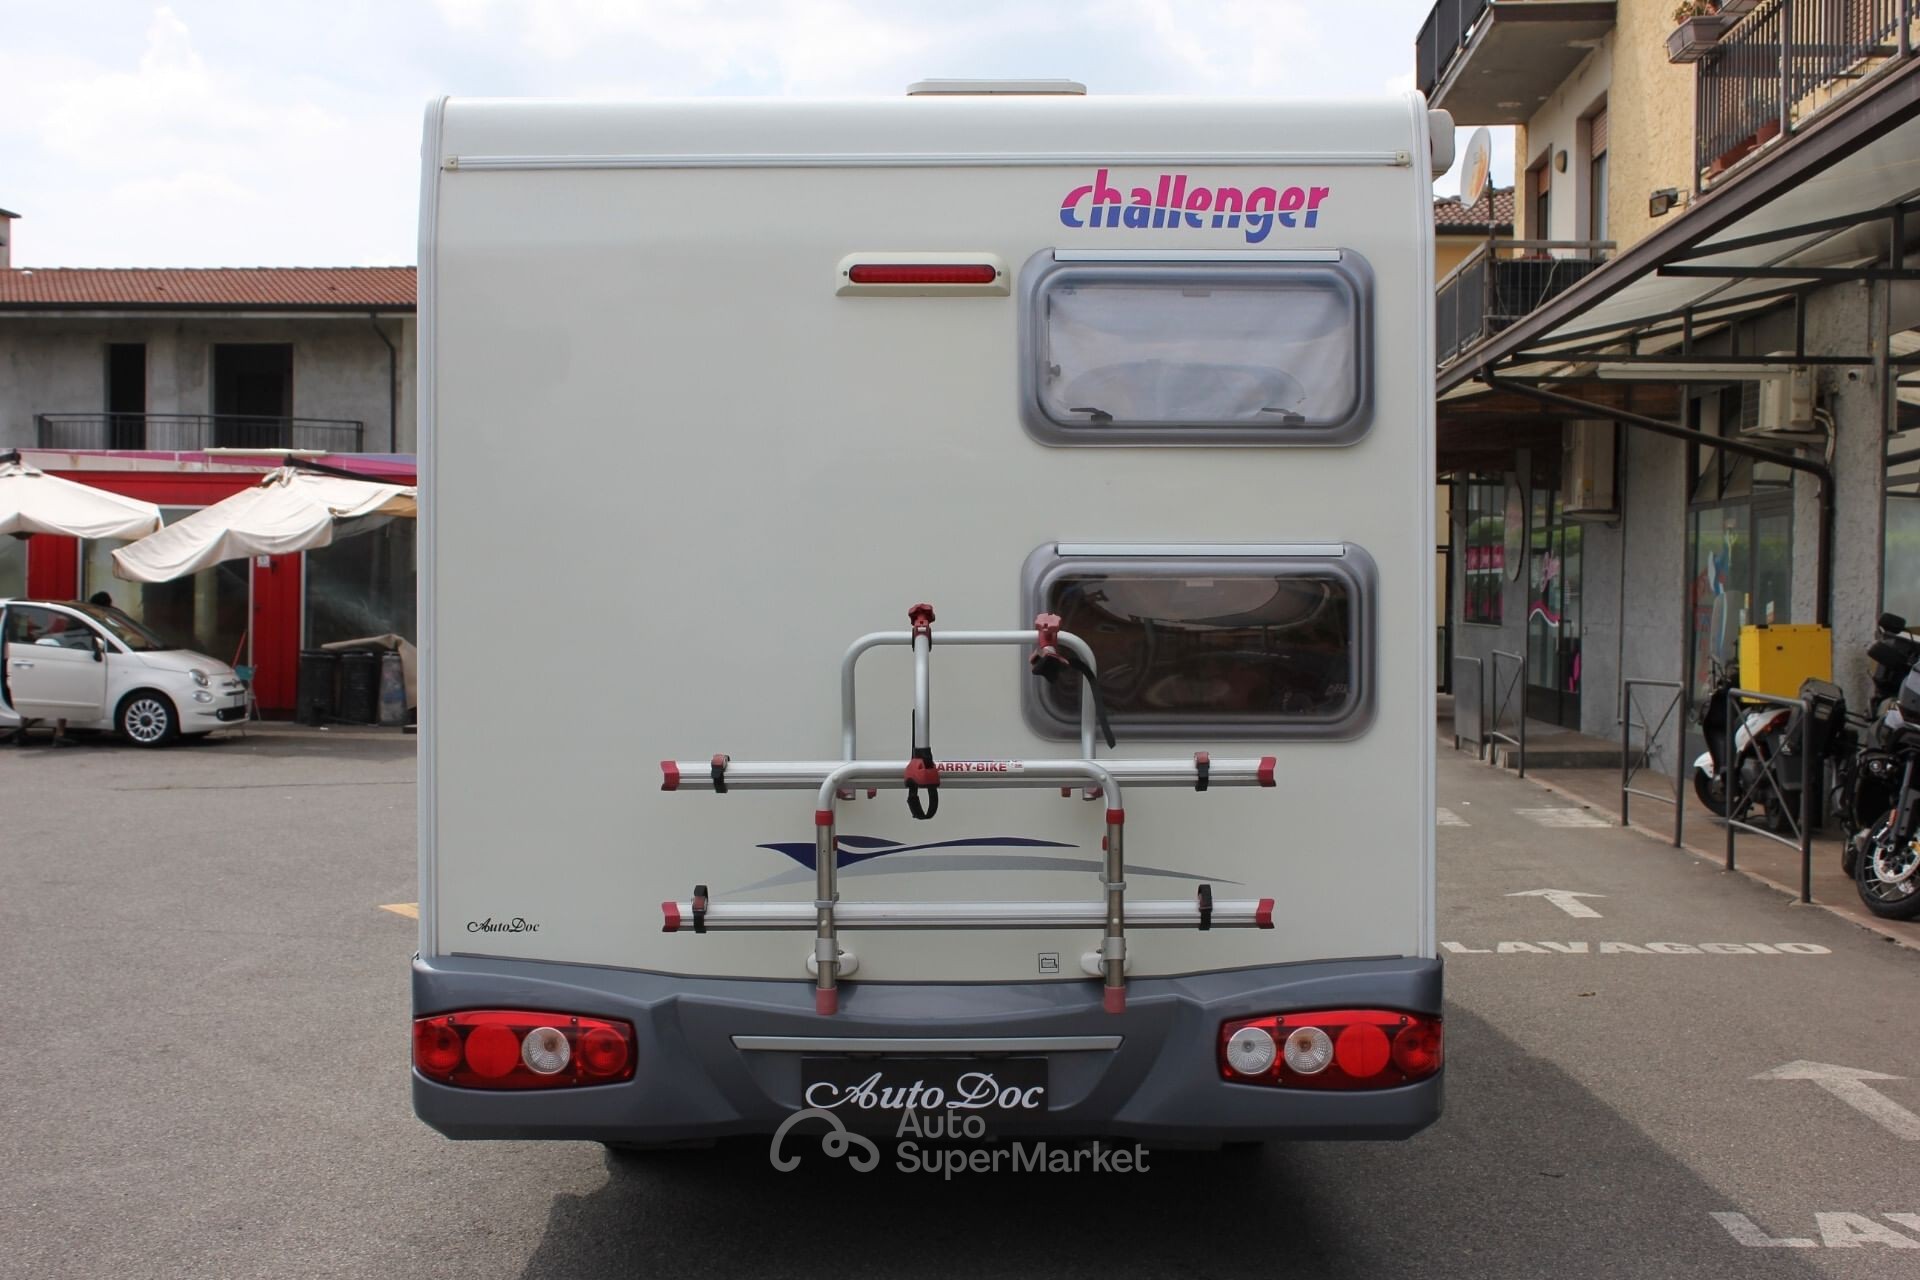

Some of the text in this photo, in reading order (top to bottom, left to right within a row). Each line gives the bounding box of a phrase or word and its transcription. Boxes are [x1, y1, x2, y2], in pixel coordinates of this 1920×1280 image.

[1060, 168, 1330, 244] challenger
[936, 762, 1007, 772] ARRY-BIKE
[805, 1071, 1044, 1109] Auto Doc
